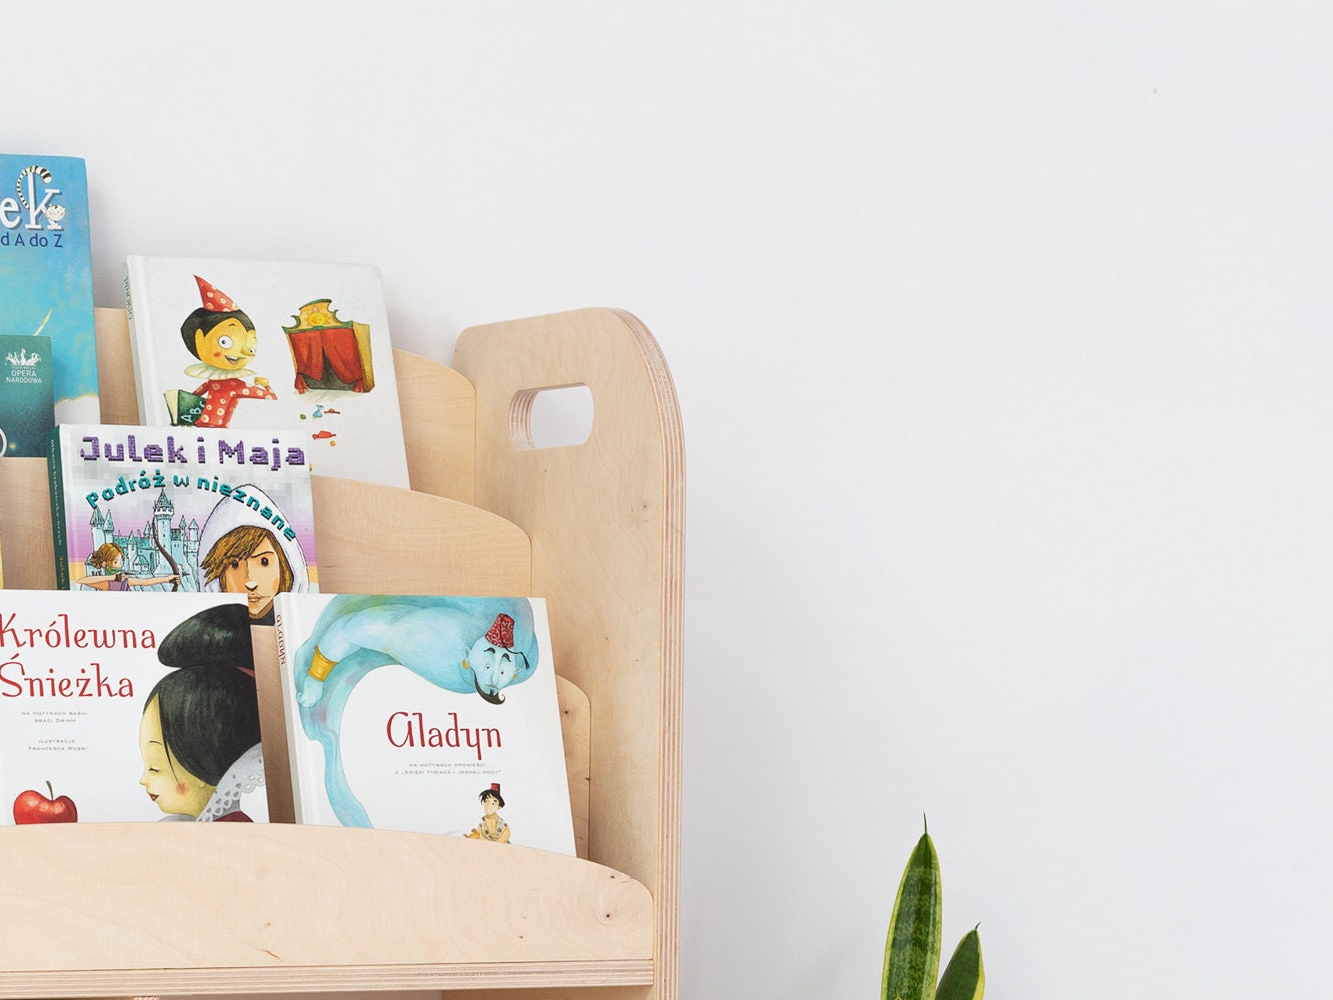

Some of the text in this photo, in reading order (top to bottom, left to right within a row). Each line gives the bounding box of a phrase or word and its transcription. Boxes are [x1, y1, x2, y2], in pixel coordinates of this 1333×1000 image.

[14, 231, 26, 247] A
[29, 231, 49, 248] do
[53, 233, 63, 248] Z
[6, 376, 43, 384] NARODOWA
[11, 369, 37, 377] OPERA
[80, 433, 188, 465] Julek
[197, 435, 207, 465] i
[218, 437, 305, 472] Maja
[85, 468, 297, 542] Podróż w nieznane
[386, 710, 503, 761] Aladyn
